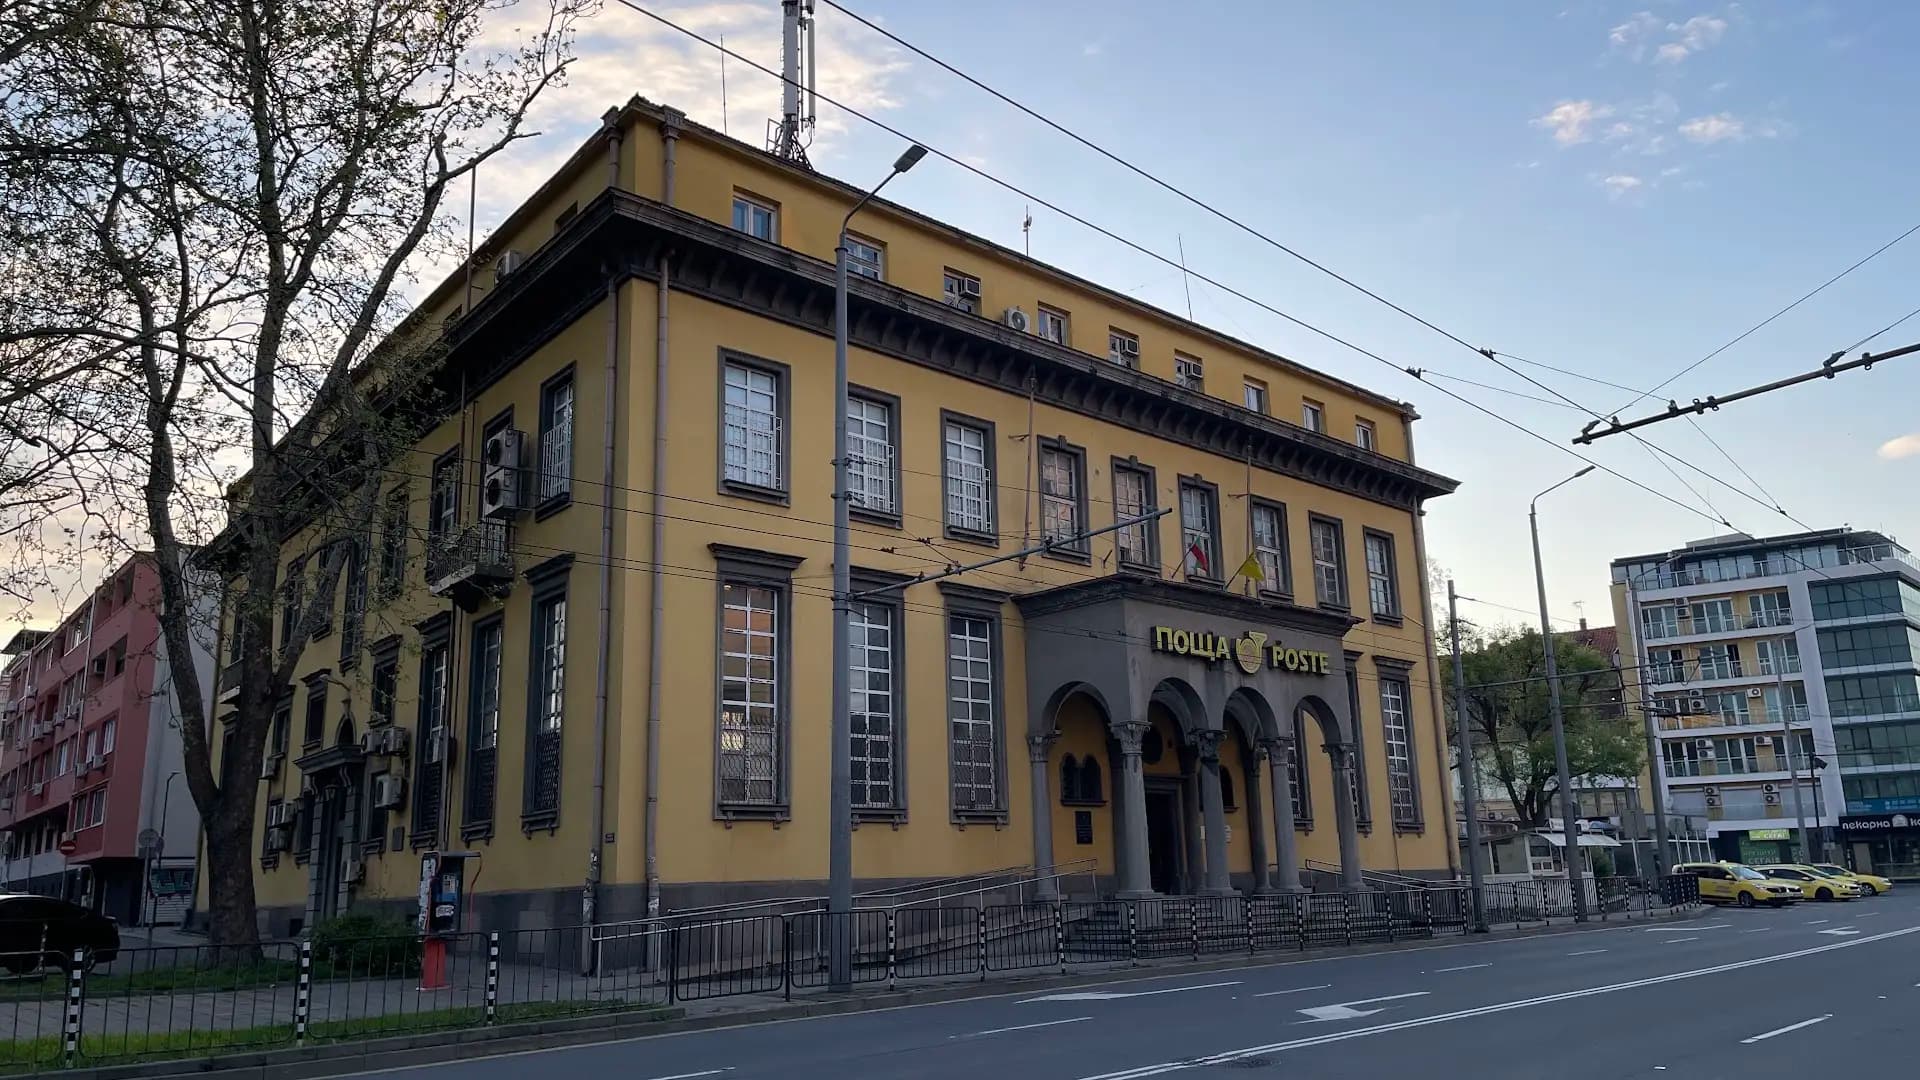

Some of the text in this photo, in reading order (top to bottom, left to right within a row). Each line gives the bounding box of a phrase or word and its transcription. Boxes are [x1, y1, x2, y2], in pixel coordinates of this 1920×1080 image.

[1155, 626, 1231, 661] ПОЩА
[1272, 645, 1330, 674] POSTE
[1842, 820, 1890, 830] пекарна
